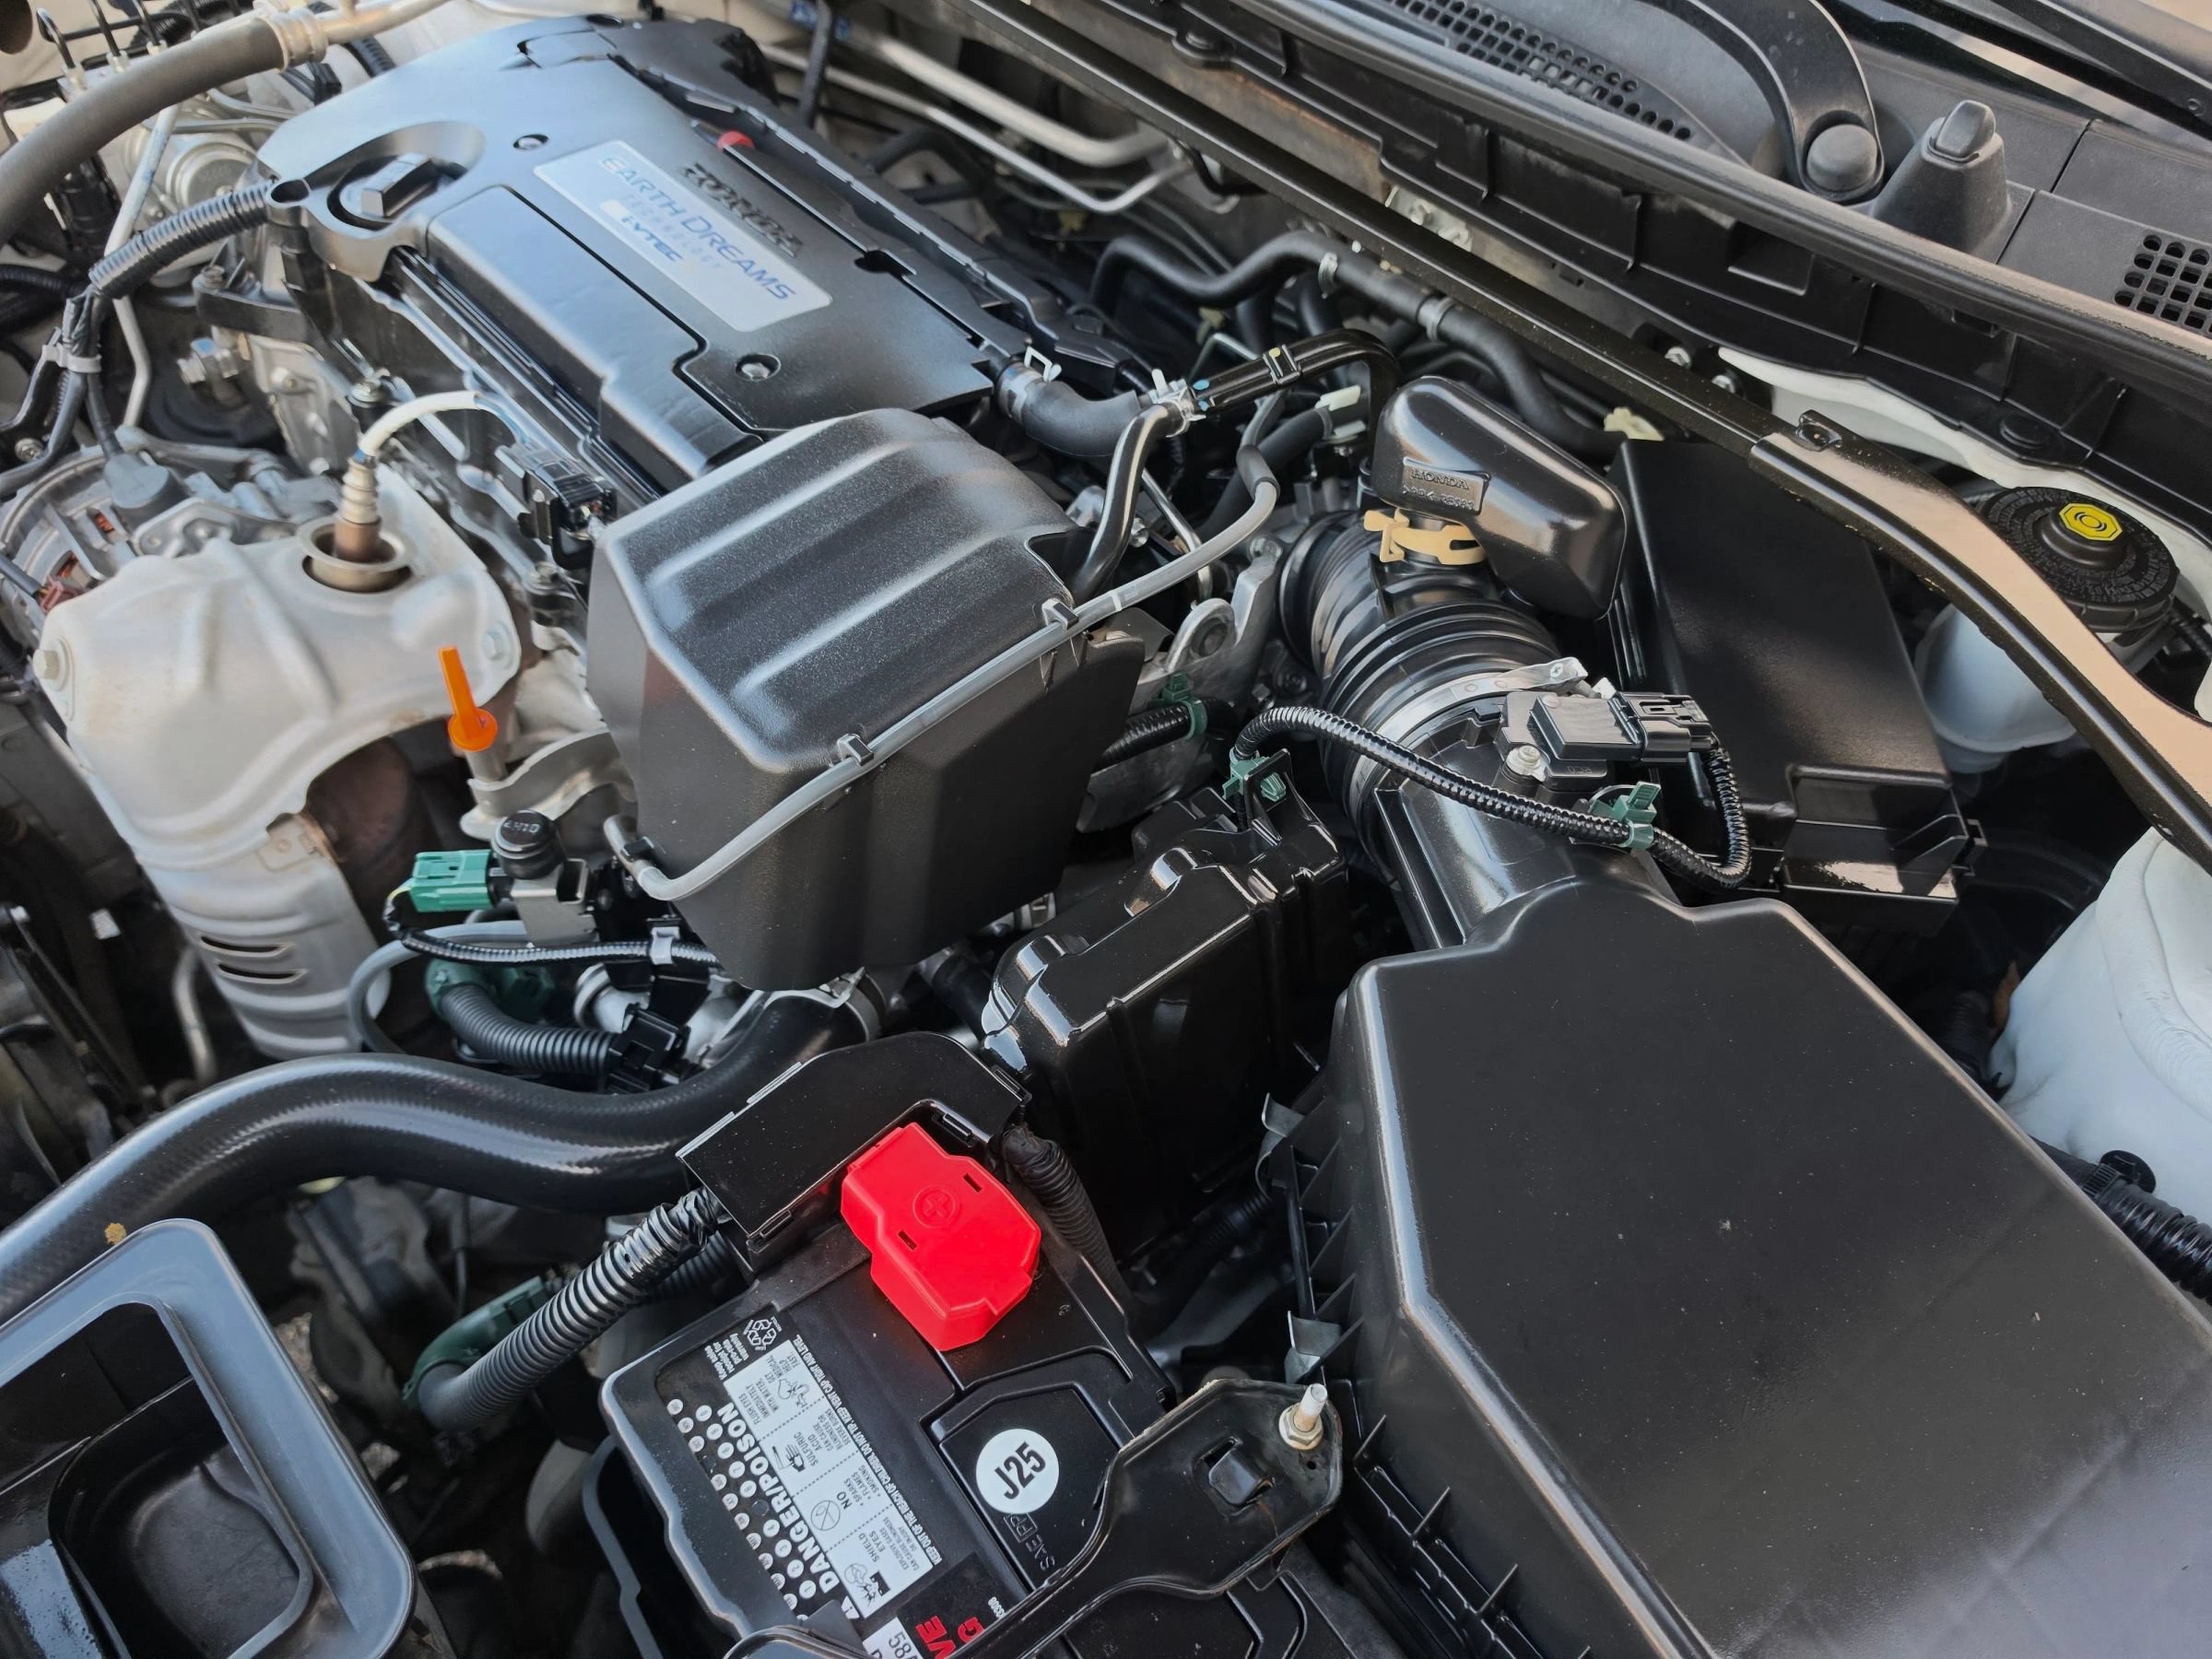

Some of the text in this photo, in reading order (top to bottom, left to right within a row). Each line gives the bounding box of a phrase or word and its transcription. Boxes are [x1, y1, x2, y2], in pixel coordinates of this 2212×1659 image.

[601, 156, 796, 301] EARTH DREAMS
[1410, 467, 1470, 490] HONDA
[712, 1359, 729, 1380] Keep
[765, 1354, 783, 1378] MEDICAL
[779, 1358, 792, 1372] HELP
[802, 1351, 816, 1367] AND
[764, 1371, 775, 1383] GET
[809, 1362, 826, 1382] TIGHT
[818, 1378, 833, 1393] CAP
[738, 1393, 761, 1424] FLUSH EYES
[745, 1383, 771, 1418] IMMEDIATELY
[766, 1396, 780, 1411] WITH
[827, 1390, 842, 1408] VENT
[836, 1405, 852, 1423] KEEP
[807, 1433, 822, 1451] ACID
[812, 1422, 833, 1451] CAN CAUSE
[822, 1421, 843, 1449] BLINDNESS
[852, 1430, 866, 1446] NOT
[793, 1430, 818, 1466] SULFURIC
[860, 1442, 872, 1455] DO
[857, 1464, 879, 1493] SMOKING
[994, 1441, 1047, 1500] J25
[843, 1477, 862, 1502] SPARKS
[851, 1471, 869, 1496] FLAMES
[884, 1481, 897, 1493] OF
[715, 1401, 841, 1593] DANGER/POISON
[835, 1490, 852, 1509] NO
[889, 1489, 910, 1513] REACH
[902, 1510, 918, 1525] THE
[911, 1522, 924, 1535] OF
[916, 1531, 932, 1547] OUT
[856, 1531, 880, 1562] SHIELD
[867, 1529, 886, 1552] EYES
[898, 1542, 912, 1560] CAUSE
[924, 1544, 943, 1565] KEEP
[1022, 1533, 1059, 1572] SAE
